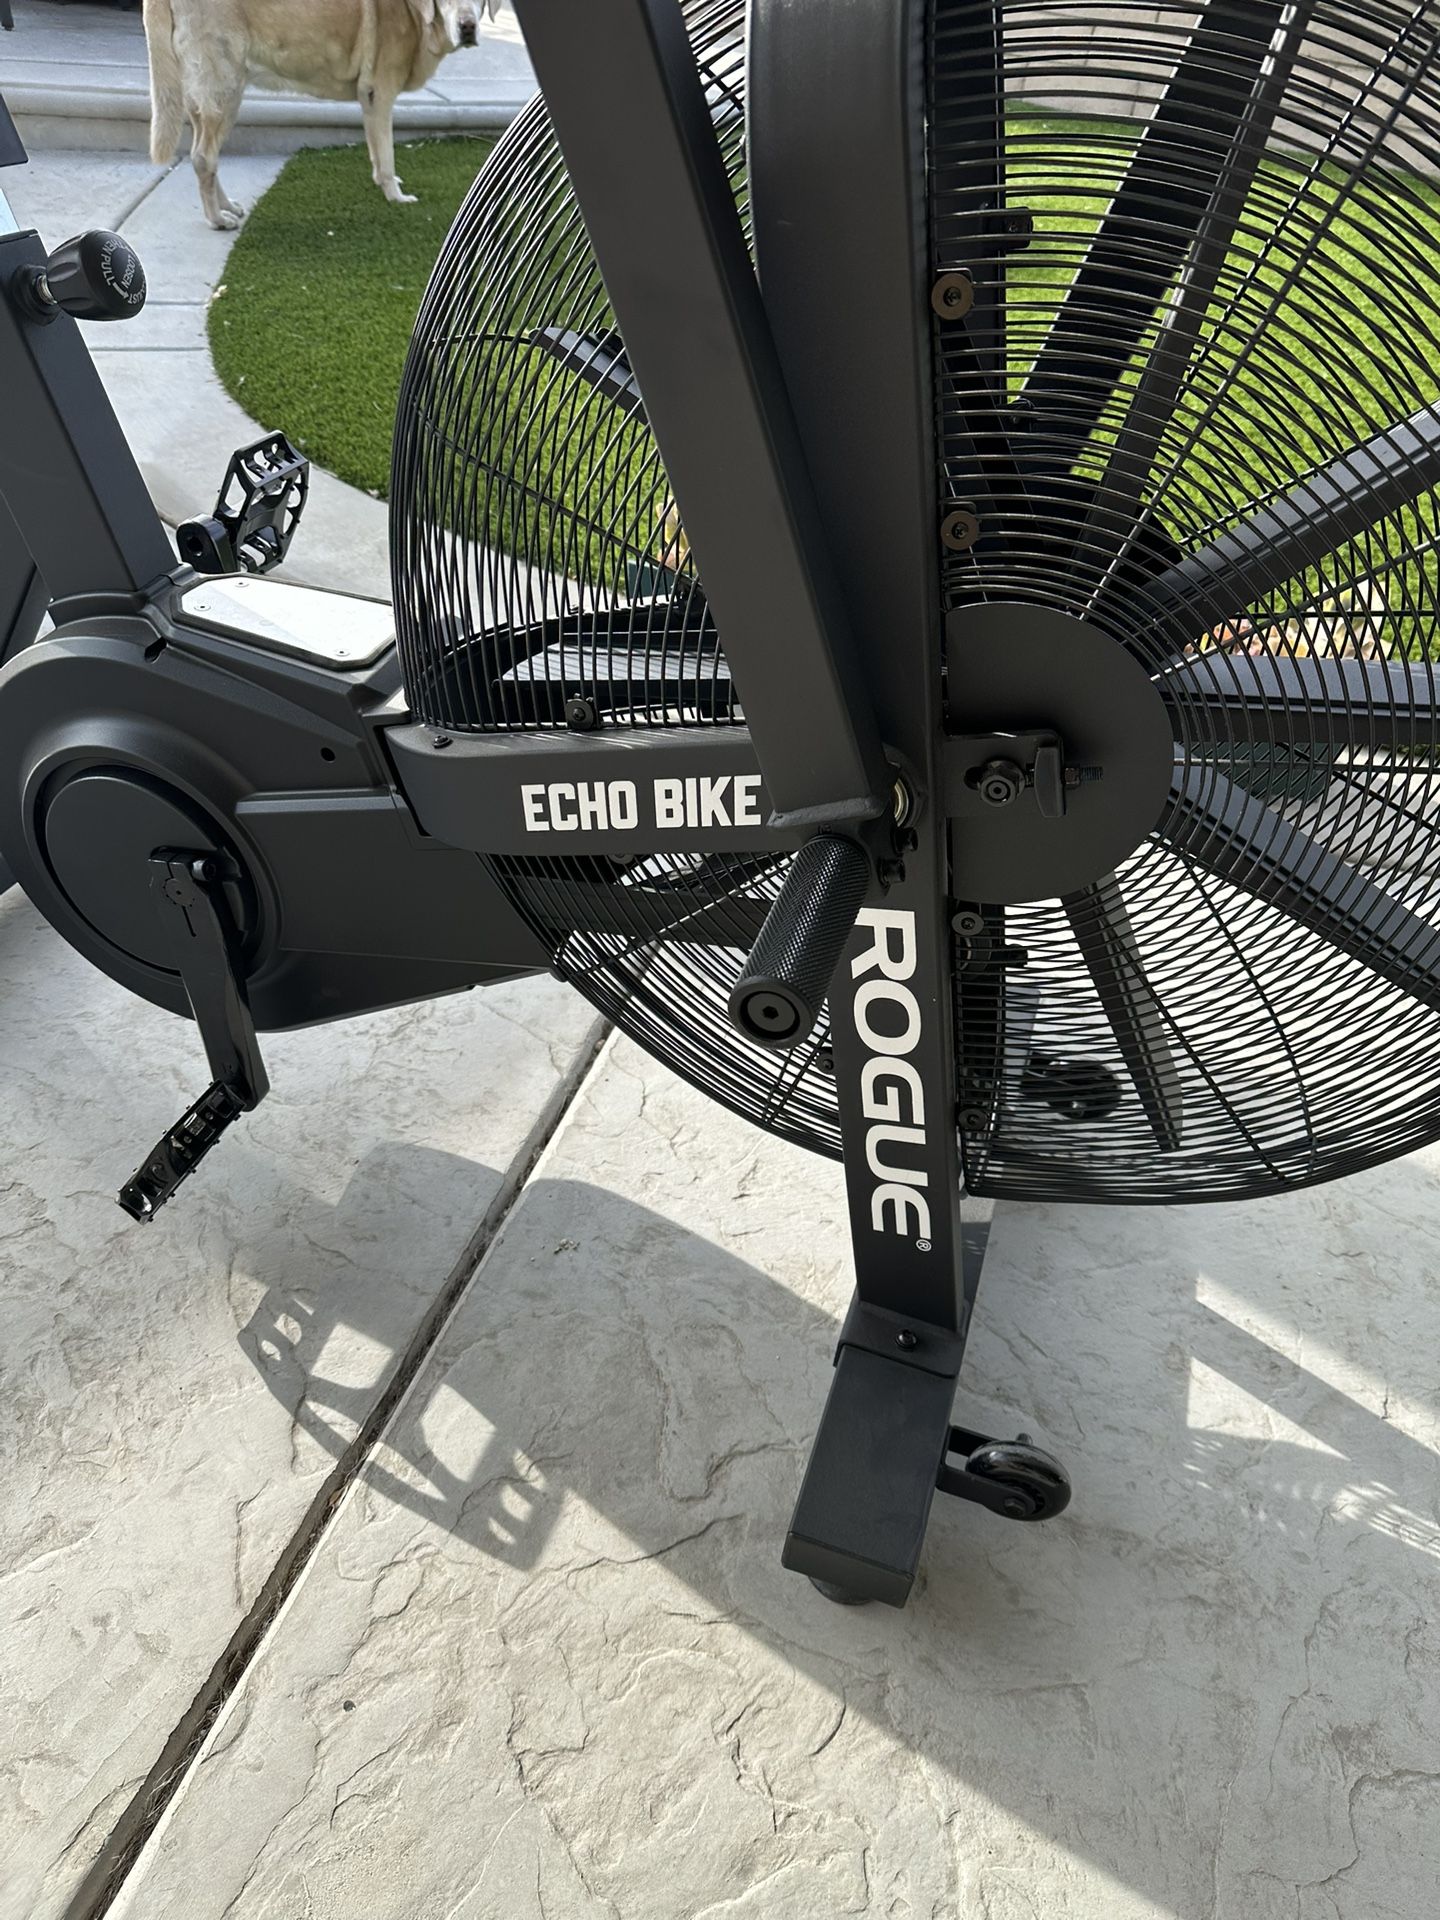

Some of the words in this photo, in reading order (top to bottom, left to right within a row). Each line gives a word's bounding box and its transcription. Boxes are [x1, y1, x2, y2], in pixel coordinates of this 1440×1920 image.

[101, 253, 115, 286] PULL
[121, 254, 136, 289] LOOSEN
[521, 780, 638, 831] ECHO
[653, 774, 762, 829] BIKE
